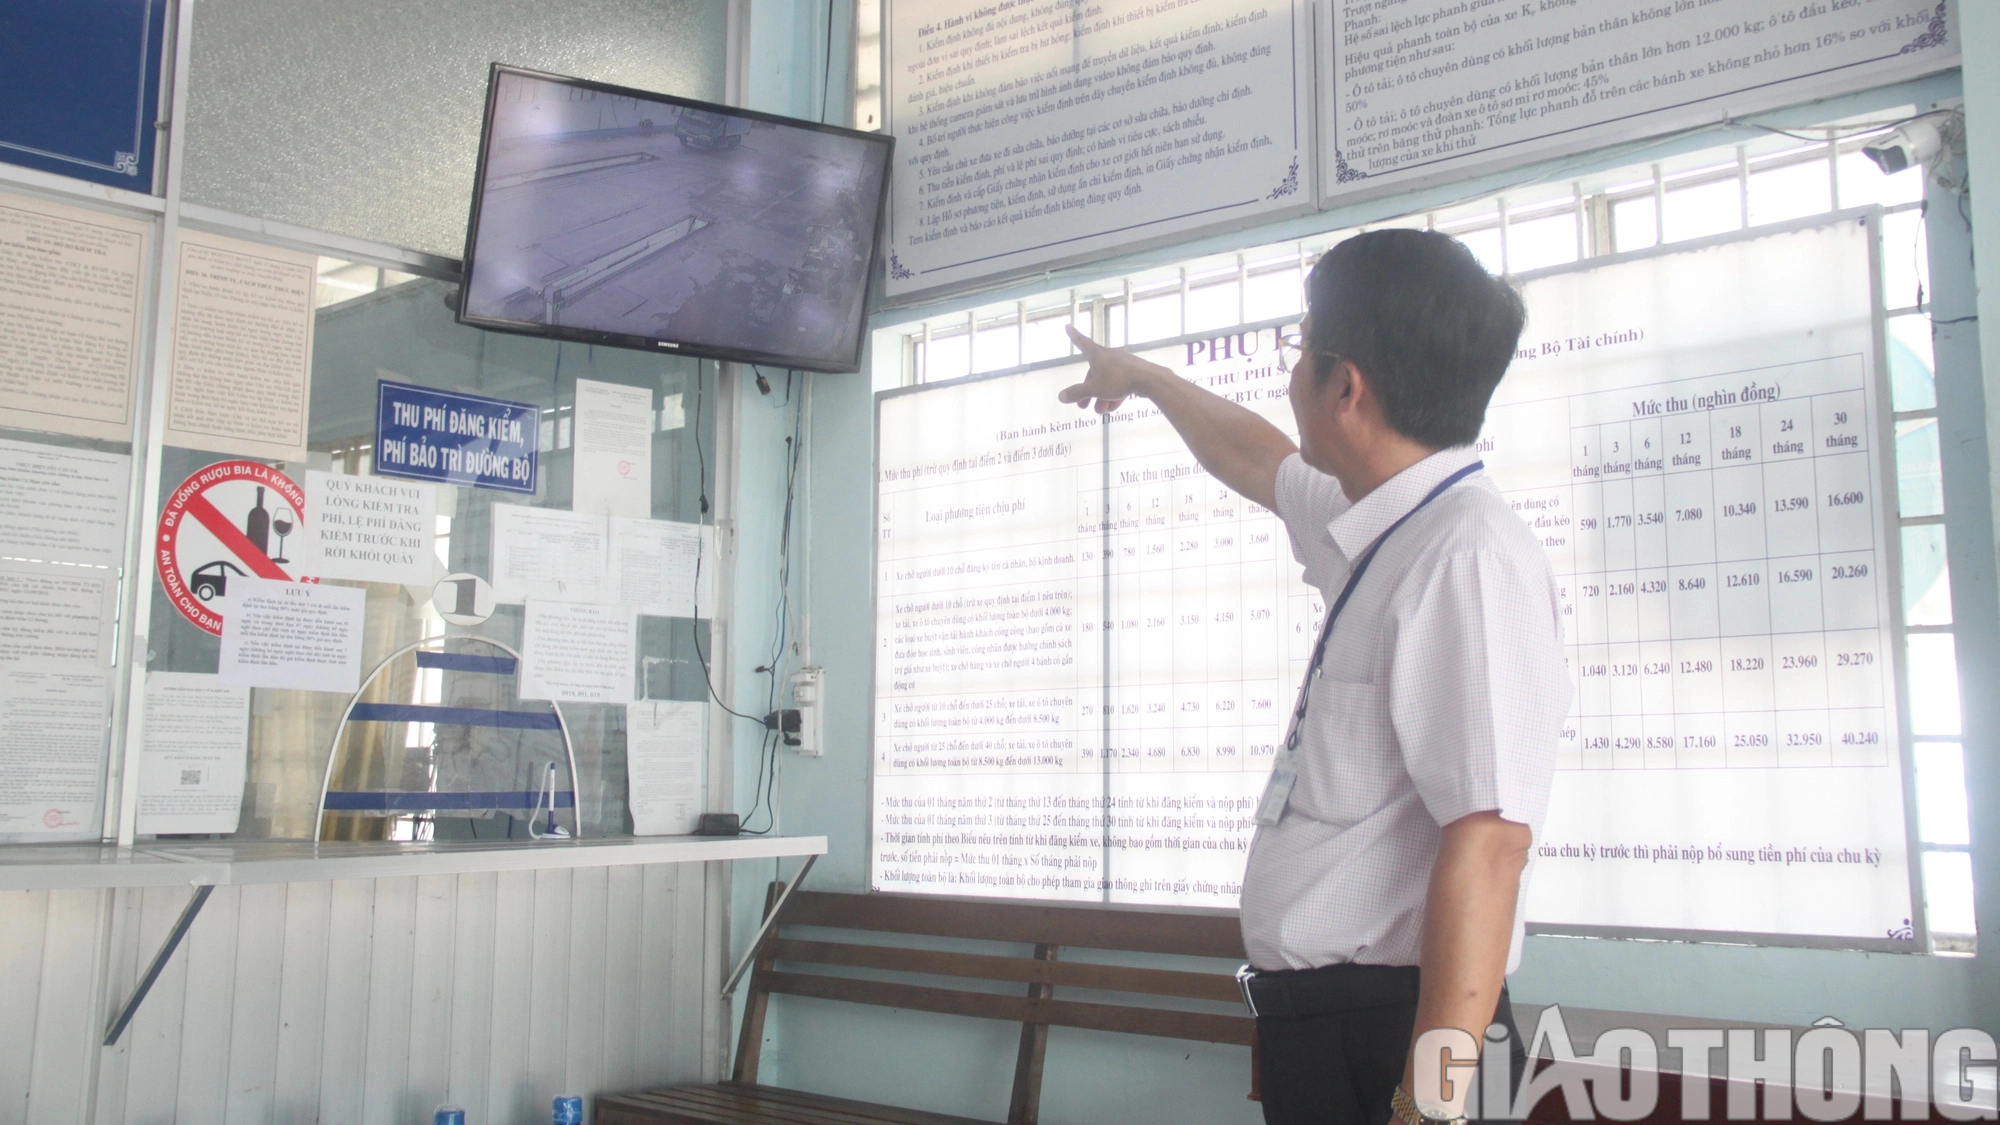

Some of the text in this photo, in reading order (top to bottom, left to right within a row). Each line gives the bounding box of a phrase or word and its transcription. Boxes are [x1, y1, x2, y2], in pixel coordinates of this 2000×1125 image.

[1346, 146, 1365, 160] thử
[1367, 142, 1390, 155] trên
[1422, 127, 1441, 142] thử
[1444, 121, 1483, 140] phanh:
[1486, 110, 1516, 126] Tổng
[1519, 107, 1536, 119] lực
[1540, 97, 1578, 115] phanh
[1582, 88, 1596, 104] đỗ
[1599, 85, 1626, 99] trên
[1629, 79, 1649, 91] các
[1652, 69, 1686, 87] bánh
[1689, 68, 1704, 78] xe
[1707, 56, 1750, 74] không
[1754, 44, 1780, 63] nhỏ
[1783, 42, 1810, 56] hơn
[1815, 31, 1845, 48] 16%
[1849, 28, 1865, 40] so
[1868, 18, 1891, 34] với
[1895, 12, 1930, 29] khối
[908, 184, 1143, 245] Tem kiểm định và báo cáo kết quả kiểm định không đúng quy định.
[1185, 331, 1258, 366] PHỤ
[1542, 329, 1643, 356] Bộ Tài chính)
[1208, 363, 1272, 386] THU PHÍ
[1632, 383, 1780, 416] Mức thu (nghìn đồng)
[393, 402, 524, 448] THU PHÍ ĐĂNG KIỂM,
[996, 409, 1149, 440] (Ban hành kèm theo Thông tư
[1583, 412, 1847, 456] 1 3 6 12 18 24 30
[383, 436, 530, 485] PHÍ BẢO TRÌ ĐƯỜNG BỘ
[1120, 463, 1190, 483] Mức thu (nghìn
[165, 509, 178, 527] ĐÃ
[174, 481, 200, 509] UỐNG
[201, 466, 231, 484] RƯỢU
[234, 465, 252, 475] BIA
[255, 468, 268, 479] LÀ
[326, 479, 421, 499] QUÝ KHÁCH VUI
[1580, 491, 1864, 530] 590 1.770 3.540 7.080 10.340 13.590 16.600
[161, 550, 222, 631] AN TOÀN CHO BẠN
[442, 578, 486, 618] 1
[1582, 564, 1867, 598] 720 2.160 4.320 8.640 12.610 16.590 20.260
[1582, 653, 1873, 677] 1.040 3.120 6.240 12.480 18.220 23.960 29.270
[1082, 748, 1093, 758] 390
[1147, 747, 1166, 757] 4.680
[1181, 747, 1200, 756] 6.830
[1216, 746, 1235, 756] 8.990
[1250, 745, 1274, 755] 10.970
[1584, 731, 1878, 750] 1.430 4.290 8.580 17.160 25.050 32.950 40.240
[1538, 842, 1880, 867] của chu kỳ trước thì phải nộp bổ sung tiền phí của chu kỳ
